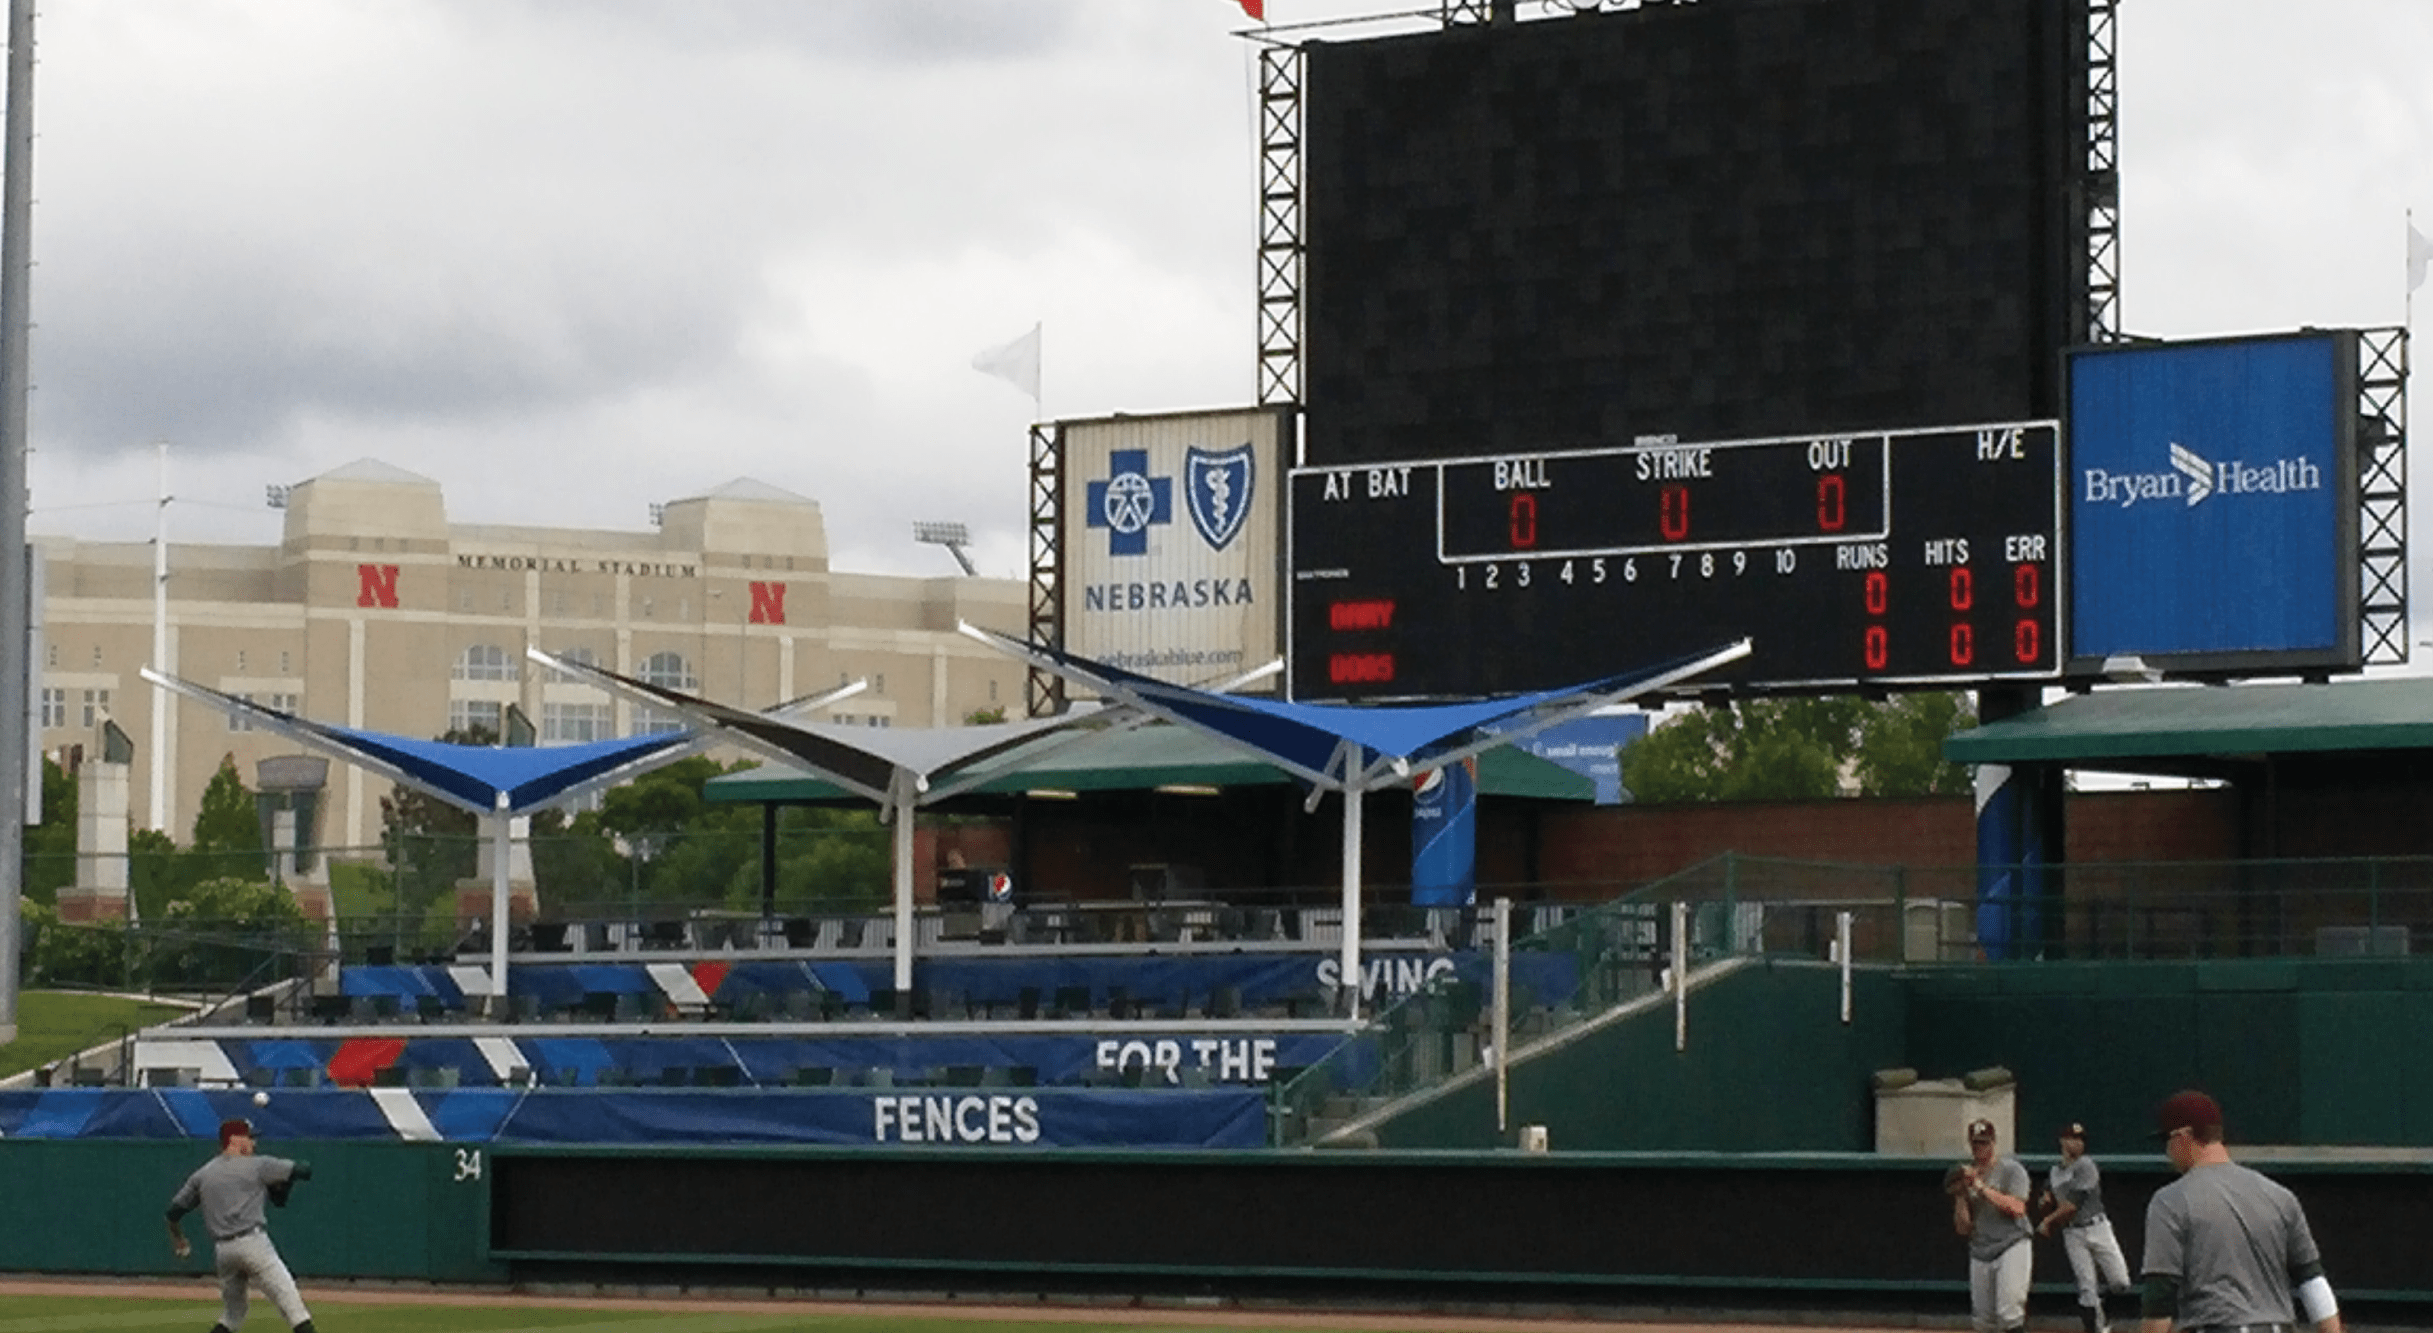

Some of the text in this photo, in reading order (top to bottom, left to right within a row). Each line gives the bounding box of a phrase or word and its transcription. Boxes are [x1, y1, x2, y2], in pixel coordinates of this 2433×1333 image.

[1494, 440, 1852, 490] BALL STRIKE OUT
[1977, 430, 2025, 460] H/E
[1324, 469, 1411, 500] AT BAT
[2084, 456, 2321, 507] Bryan Health
[1510, 494, 1536, 548] 0
[1817, 474, 1845, 530] 0
[457, 555, 696, 577] MEMORIAL STADIUM
[1457, 549, 1796, 590] 1 2 3 4 5 6 7 8 9 10
[1836, 535, 2046, 570] RUNS HITS ERR
[356, 563, 400, 608] N
[748, 581, 787, 625] N
[1085, 577, 1254, 612] NEBRASKA
[1865, 564, 2038, 615] 0 0 0
[1865, 618, 2038, 670] 0 0 0
[1097, 1039, 1277, 1084] FOR THE
[875, 1095, 1041, 1143] FENCES
